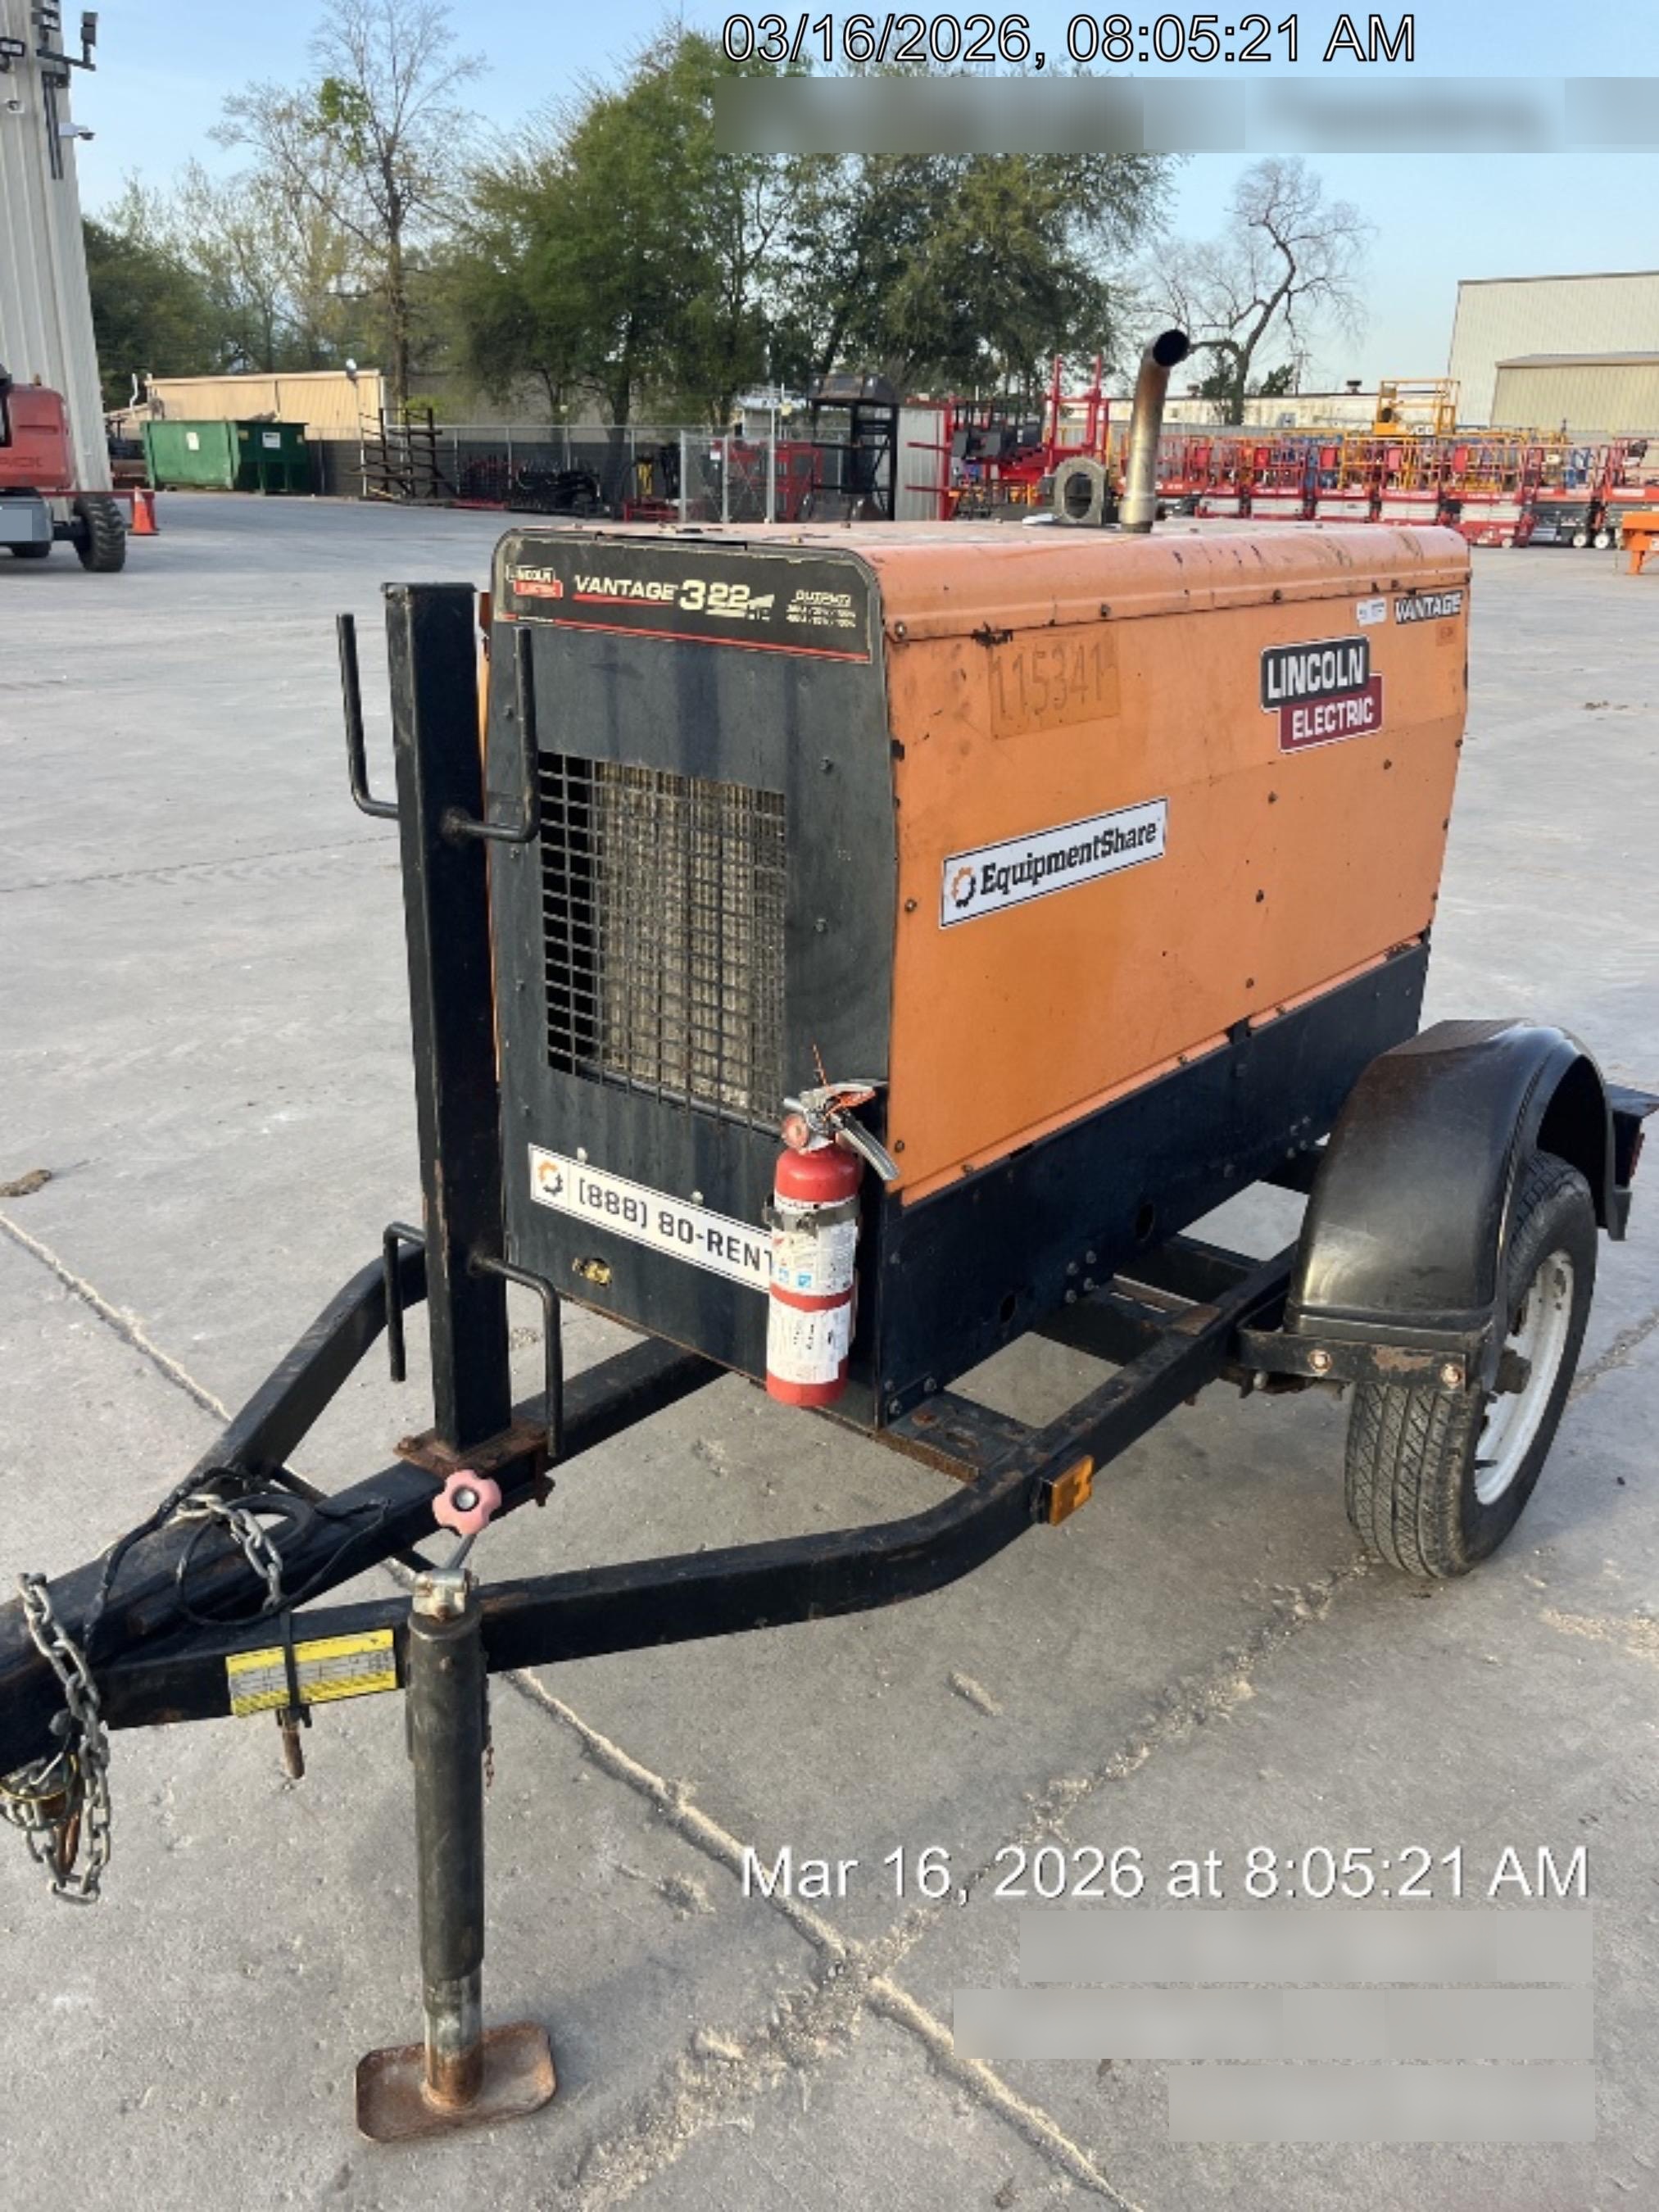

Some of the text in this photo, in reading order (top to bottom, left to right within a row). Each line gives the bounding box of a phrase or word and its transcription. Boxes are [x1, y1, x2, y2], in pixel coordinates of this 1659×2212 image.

[574, 575, 750, 611] VANTAGE 322
[1395, 592, 1462, 623] VANTAGE
[1267, 646, 1364, 700] LINCOLN
[1292, 696, 1373, 741] ELECTRIC
[980, 822, 1157, 895] EquipmentShare
